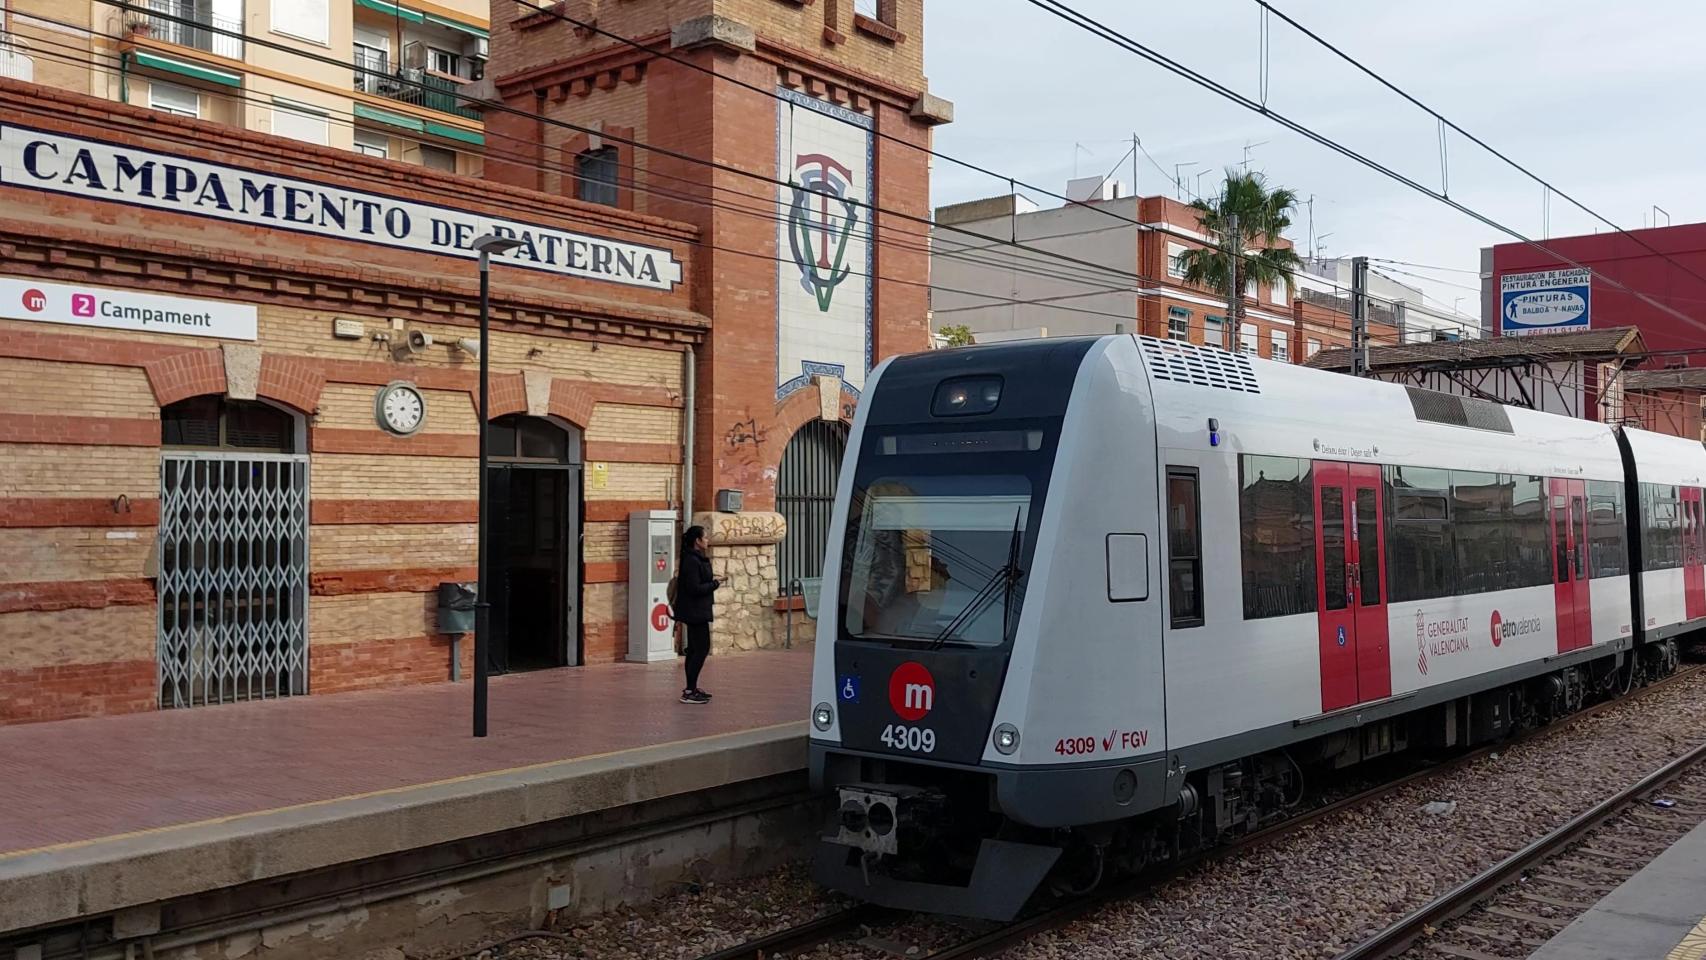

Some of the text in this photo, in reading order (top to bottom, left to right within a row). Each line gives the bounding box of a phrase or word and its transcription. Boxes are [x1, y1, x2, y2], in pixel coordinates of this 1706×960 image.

[22, 140, 412, 239] CAMPAMENTO
[430, 217, 474, 250] DE
[1502, 276, 1590, 290] PINTURA EN GENERAL
[1548, 271, 1557, 280] DE
[1522, 293, 1573, 303] PINTURAS
[77, 297, 90, 314] 2
[100, 301, 211, 327] Campament
[1522, 306, 1550, 315] BALBOA
[1561, 304, 1584, 312] NAVAS
[1427, 617, 1469, 638] GENERALITAT
[1429, 638, 1469, 656] VALENCIANA
[905, 682, 932, 710] m
[880, 724, 936, 753] 4309
[1055, 730, 1149, 755] 4309 FGV
